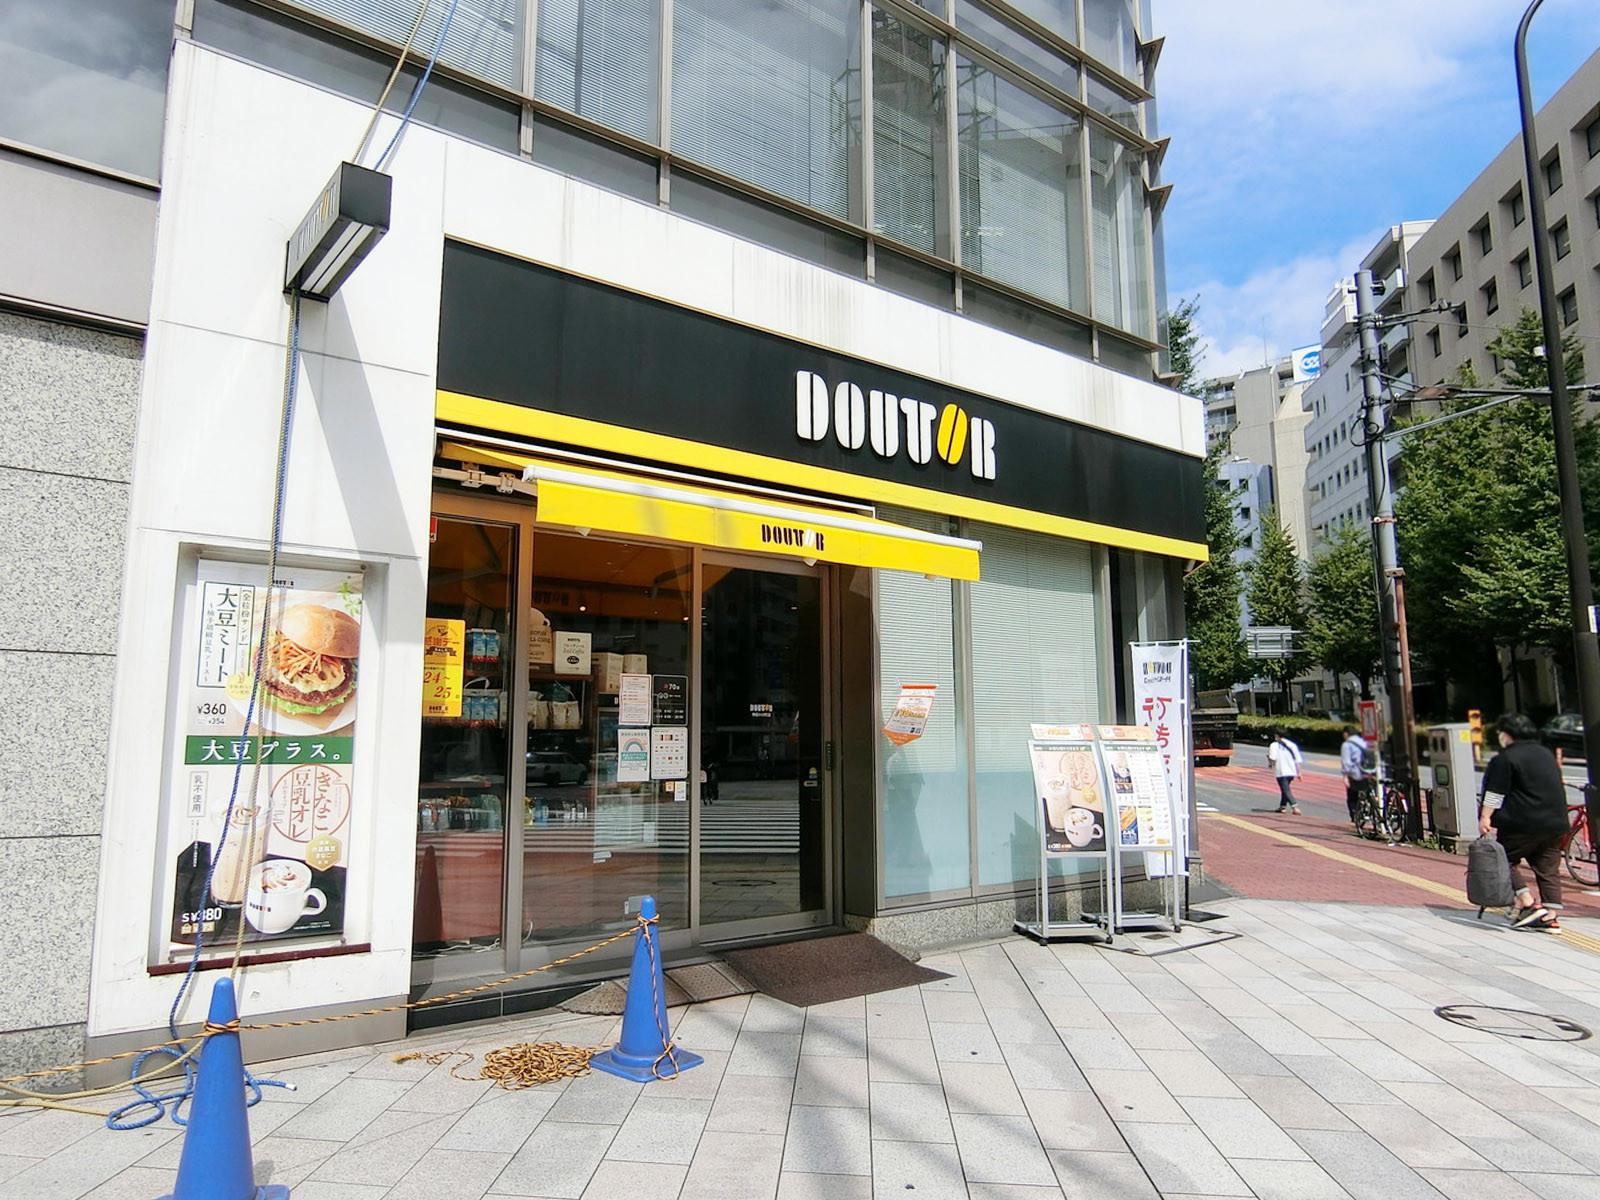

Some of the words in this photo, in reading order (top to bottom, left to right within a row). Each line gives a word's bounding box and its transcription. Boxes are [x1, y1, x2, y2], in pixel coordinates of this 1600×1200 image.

[796, 370, 996, 480] DOUTOR
[761, 523, 825, 551] DOUTOR
[215, 587, 238, 683] 大豆ミート
[197, 703, 227, 715] ¥360
[434, 686, 452, 699] 25
[201, 740, 342, 761] 大豆プラス。
[291, 769, 311, 839] 豆乳オレ
[315, 772, 333, 831] きなこ
